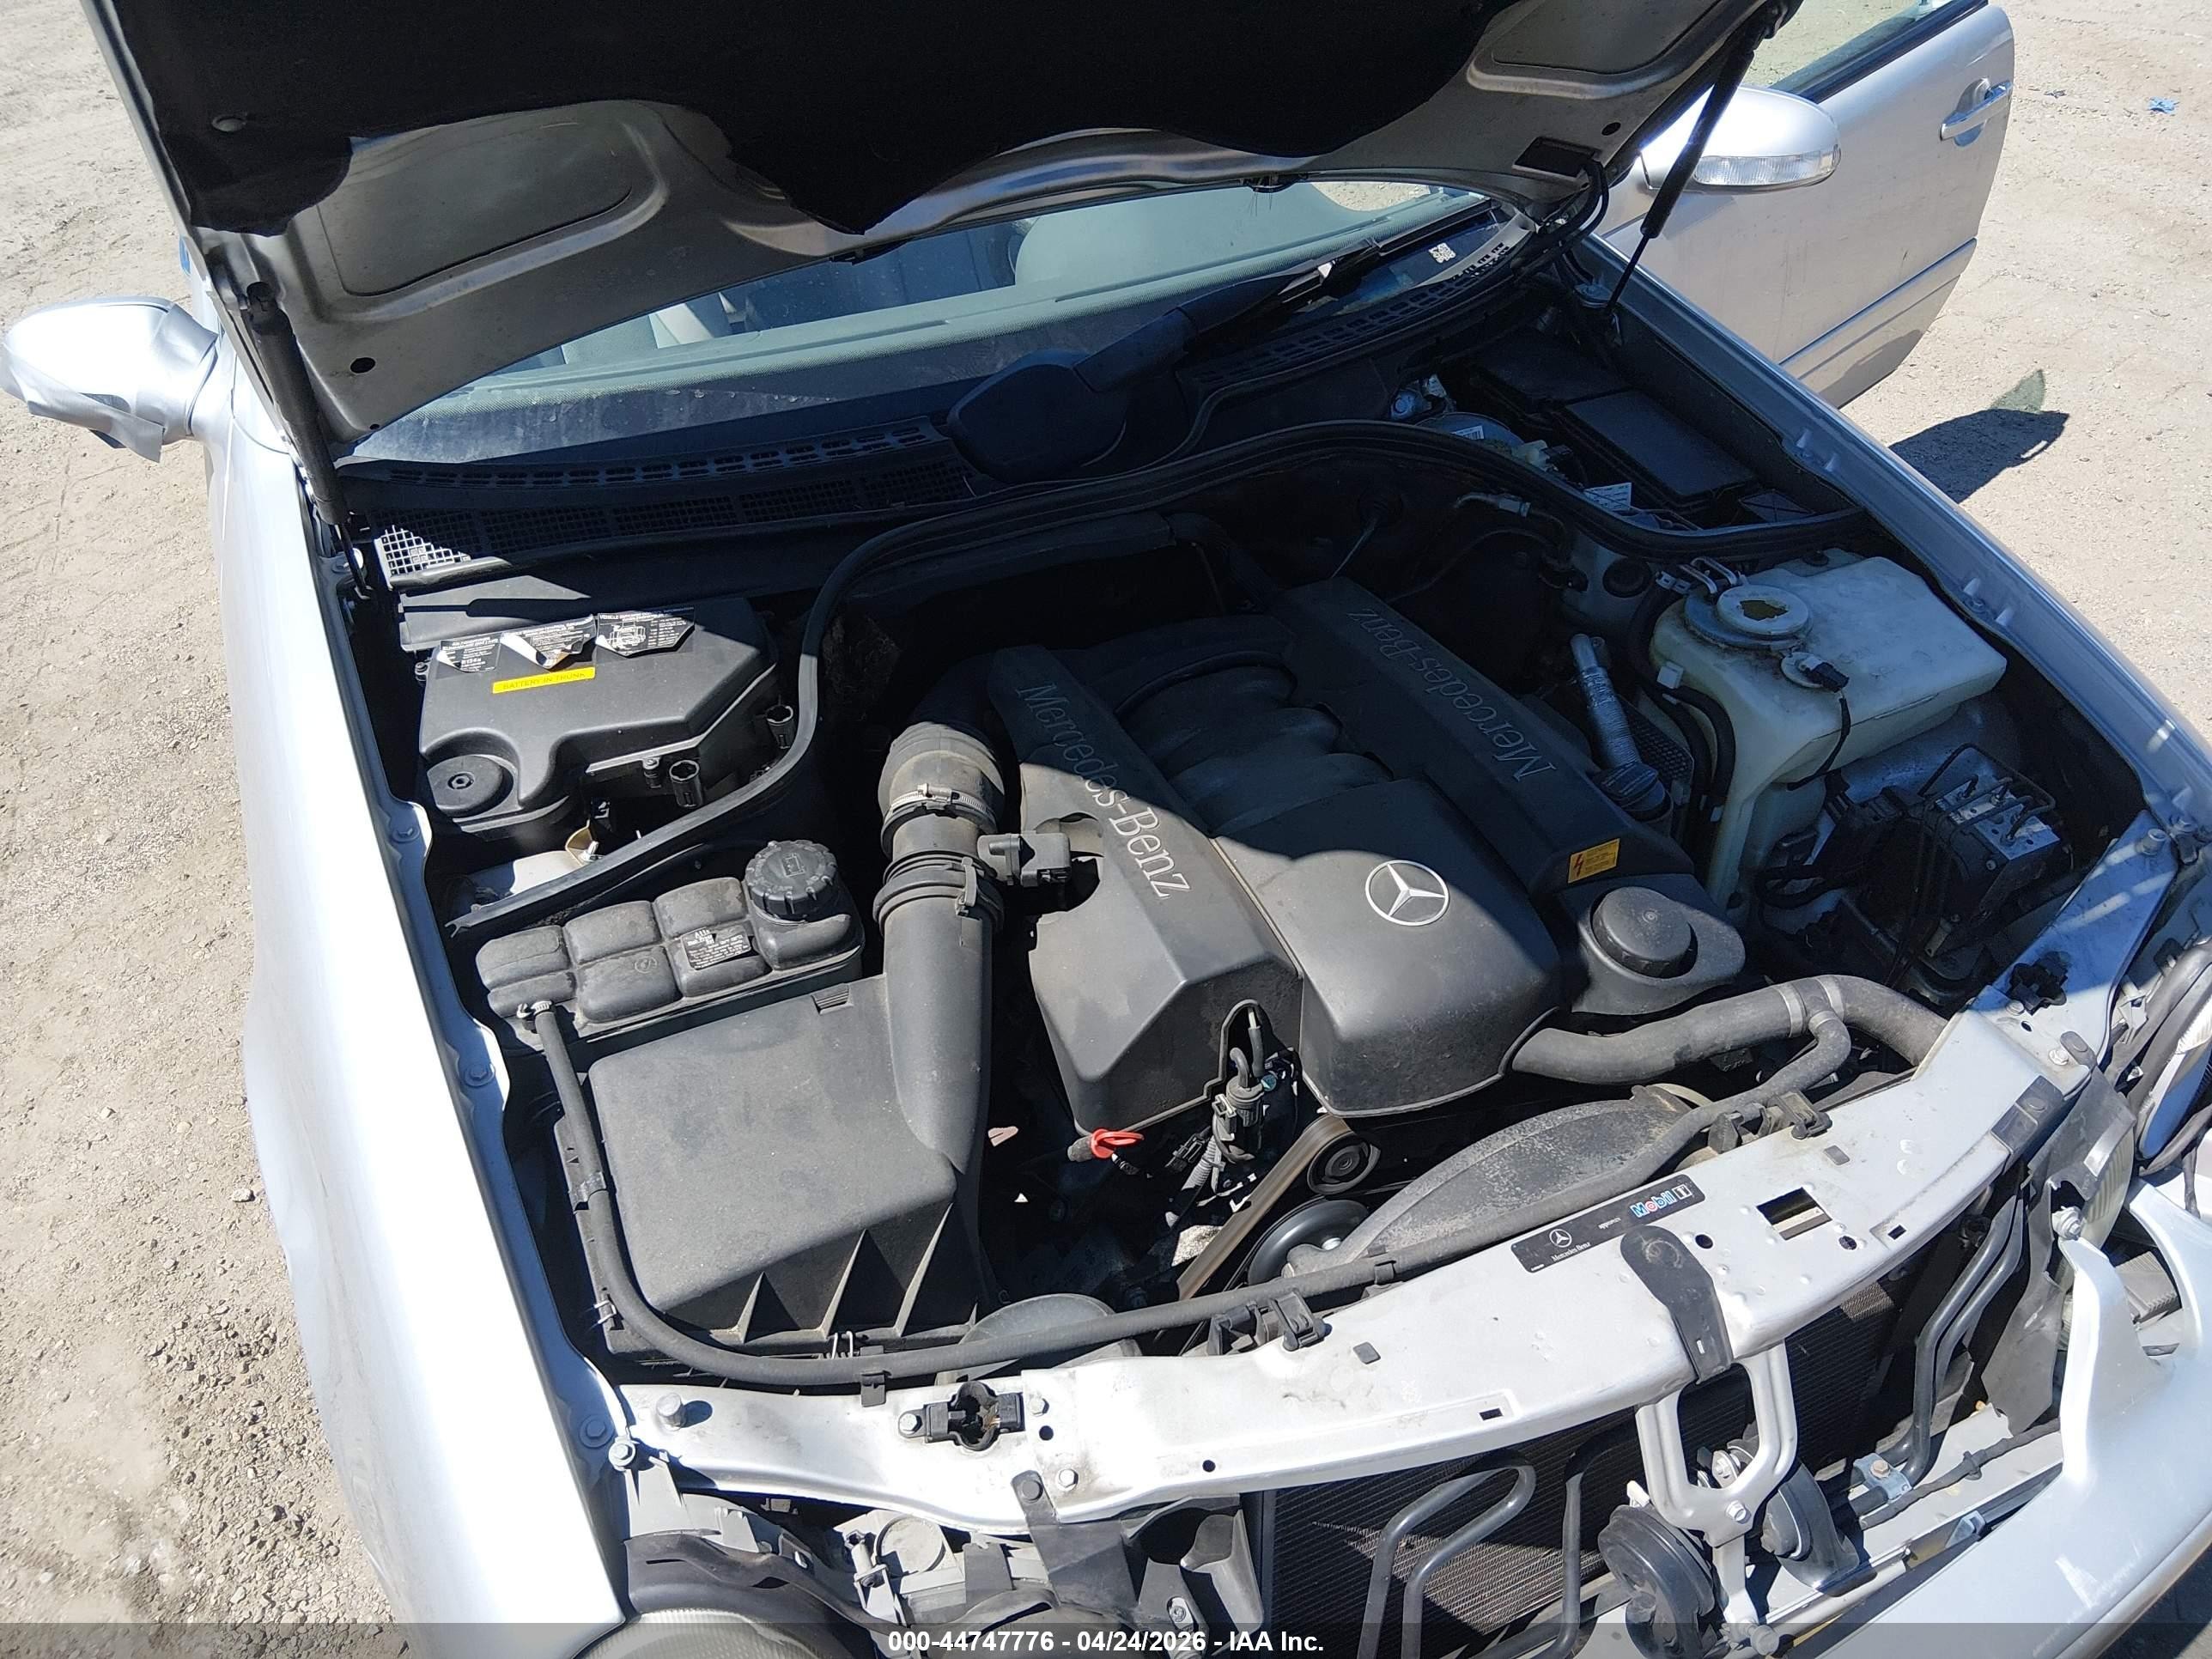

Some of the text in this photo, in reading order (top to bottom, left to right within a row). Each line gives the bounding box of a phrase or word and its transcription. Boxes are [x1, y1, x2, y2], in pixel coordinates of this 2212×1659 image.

[502, 678, 540, 690] BATTERY
[556, 672, 586, 682] TRUNK
[1346, 608, 1557, 782] Mercedes-Benz
[1015, 683, 1192, 898] Mercedes-Benz
[1629, 1190, 1678, 1218] Mobil
